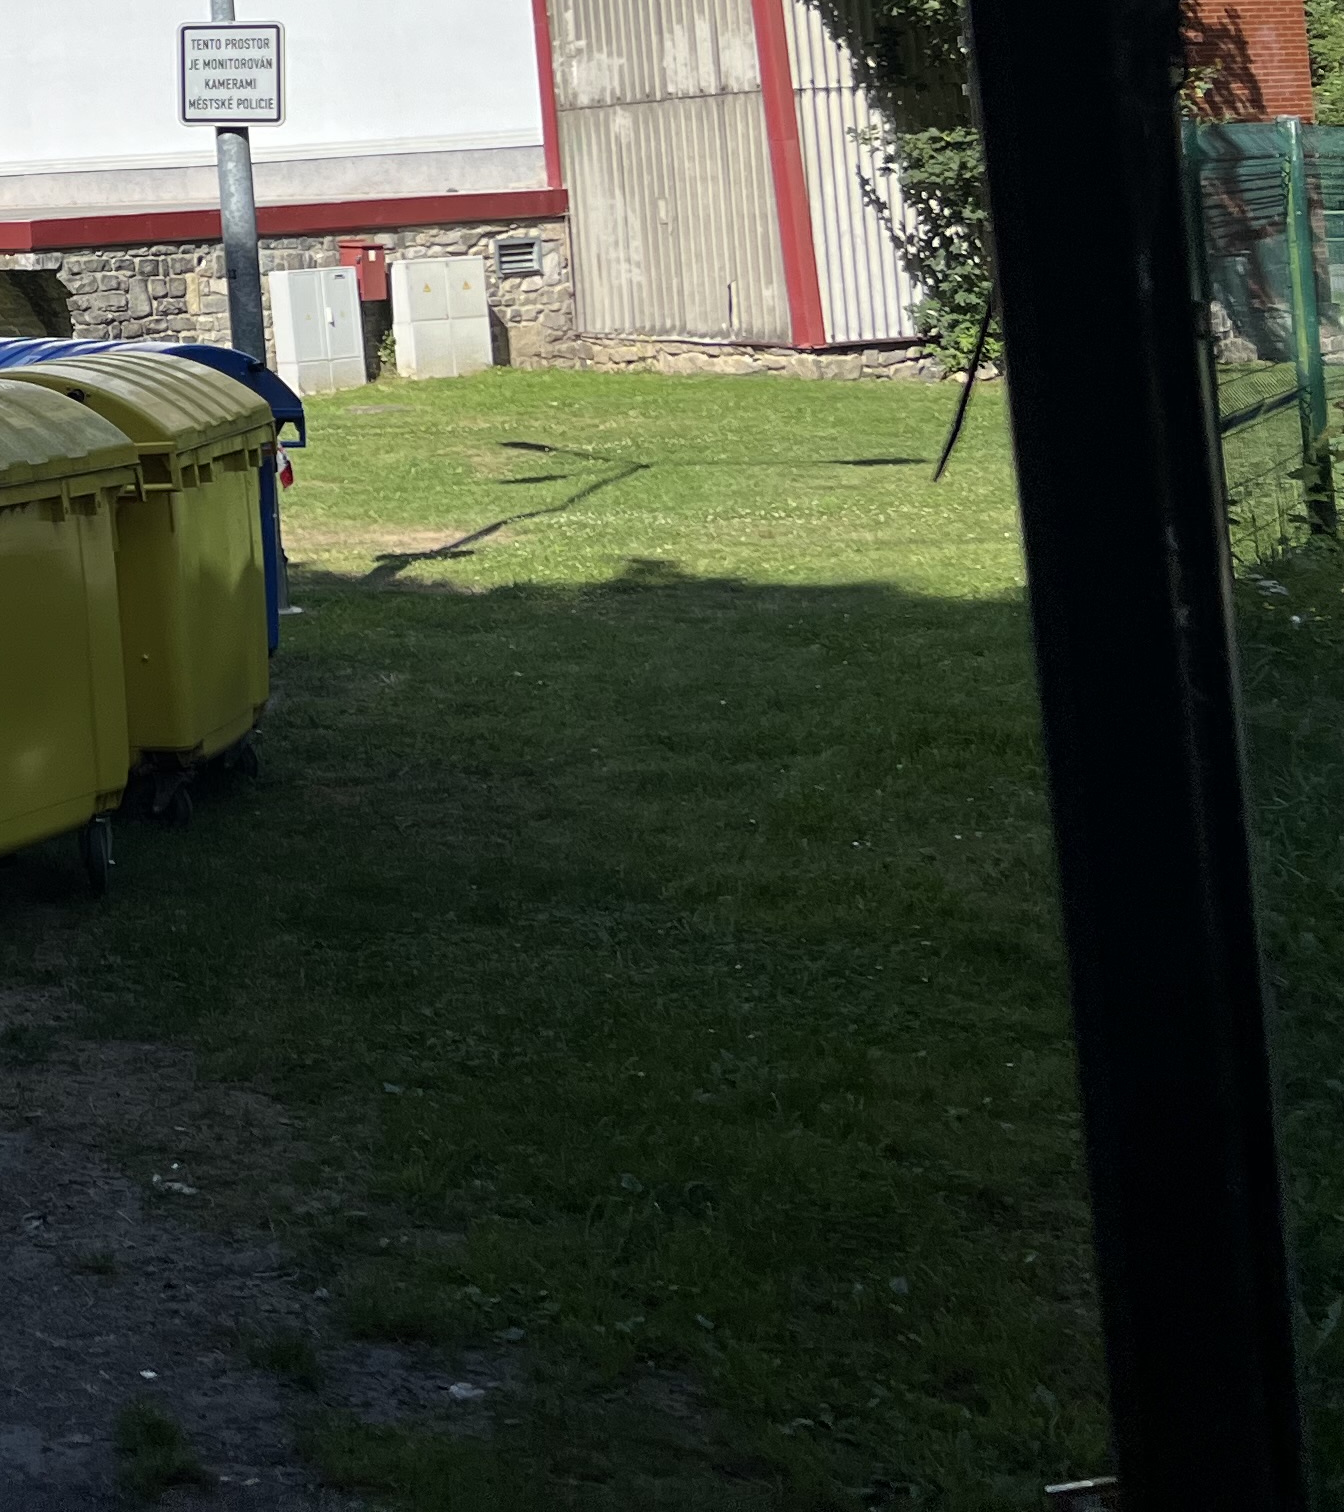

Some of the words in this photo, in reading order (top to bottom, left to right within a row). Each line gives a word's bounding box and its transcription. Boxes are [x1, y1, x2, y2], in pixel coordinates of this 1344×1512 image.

[191, 38, 221, 50] TENTO
[225, 37, 270, 50] PROSTOR
[189, 58, 200, 70] JE
[203, 55, 273, 70] MONITOROVÁN
[204, 78, 257, 90] KAMERAMI
[188, 95, 233, 110] MĚSTSKÉ
[237, 97, 274, 110] POLICIE
